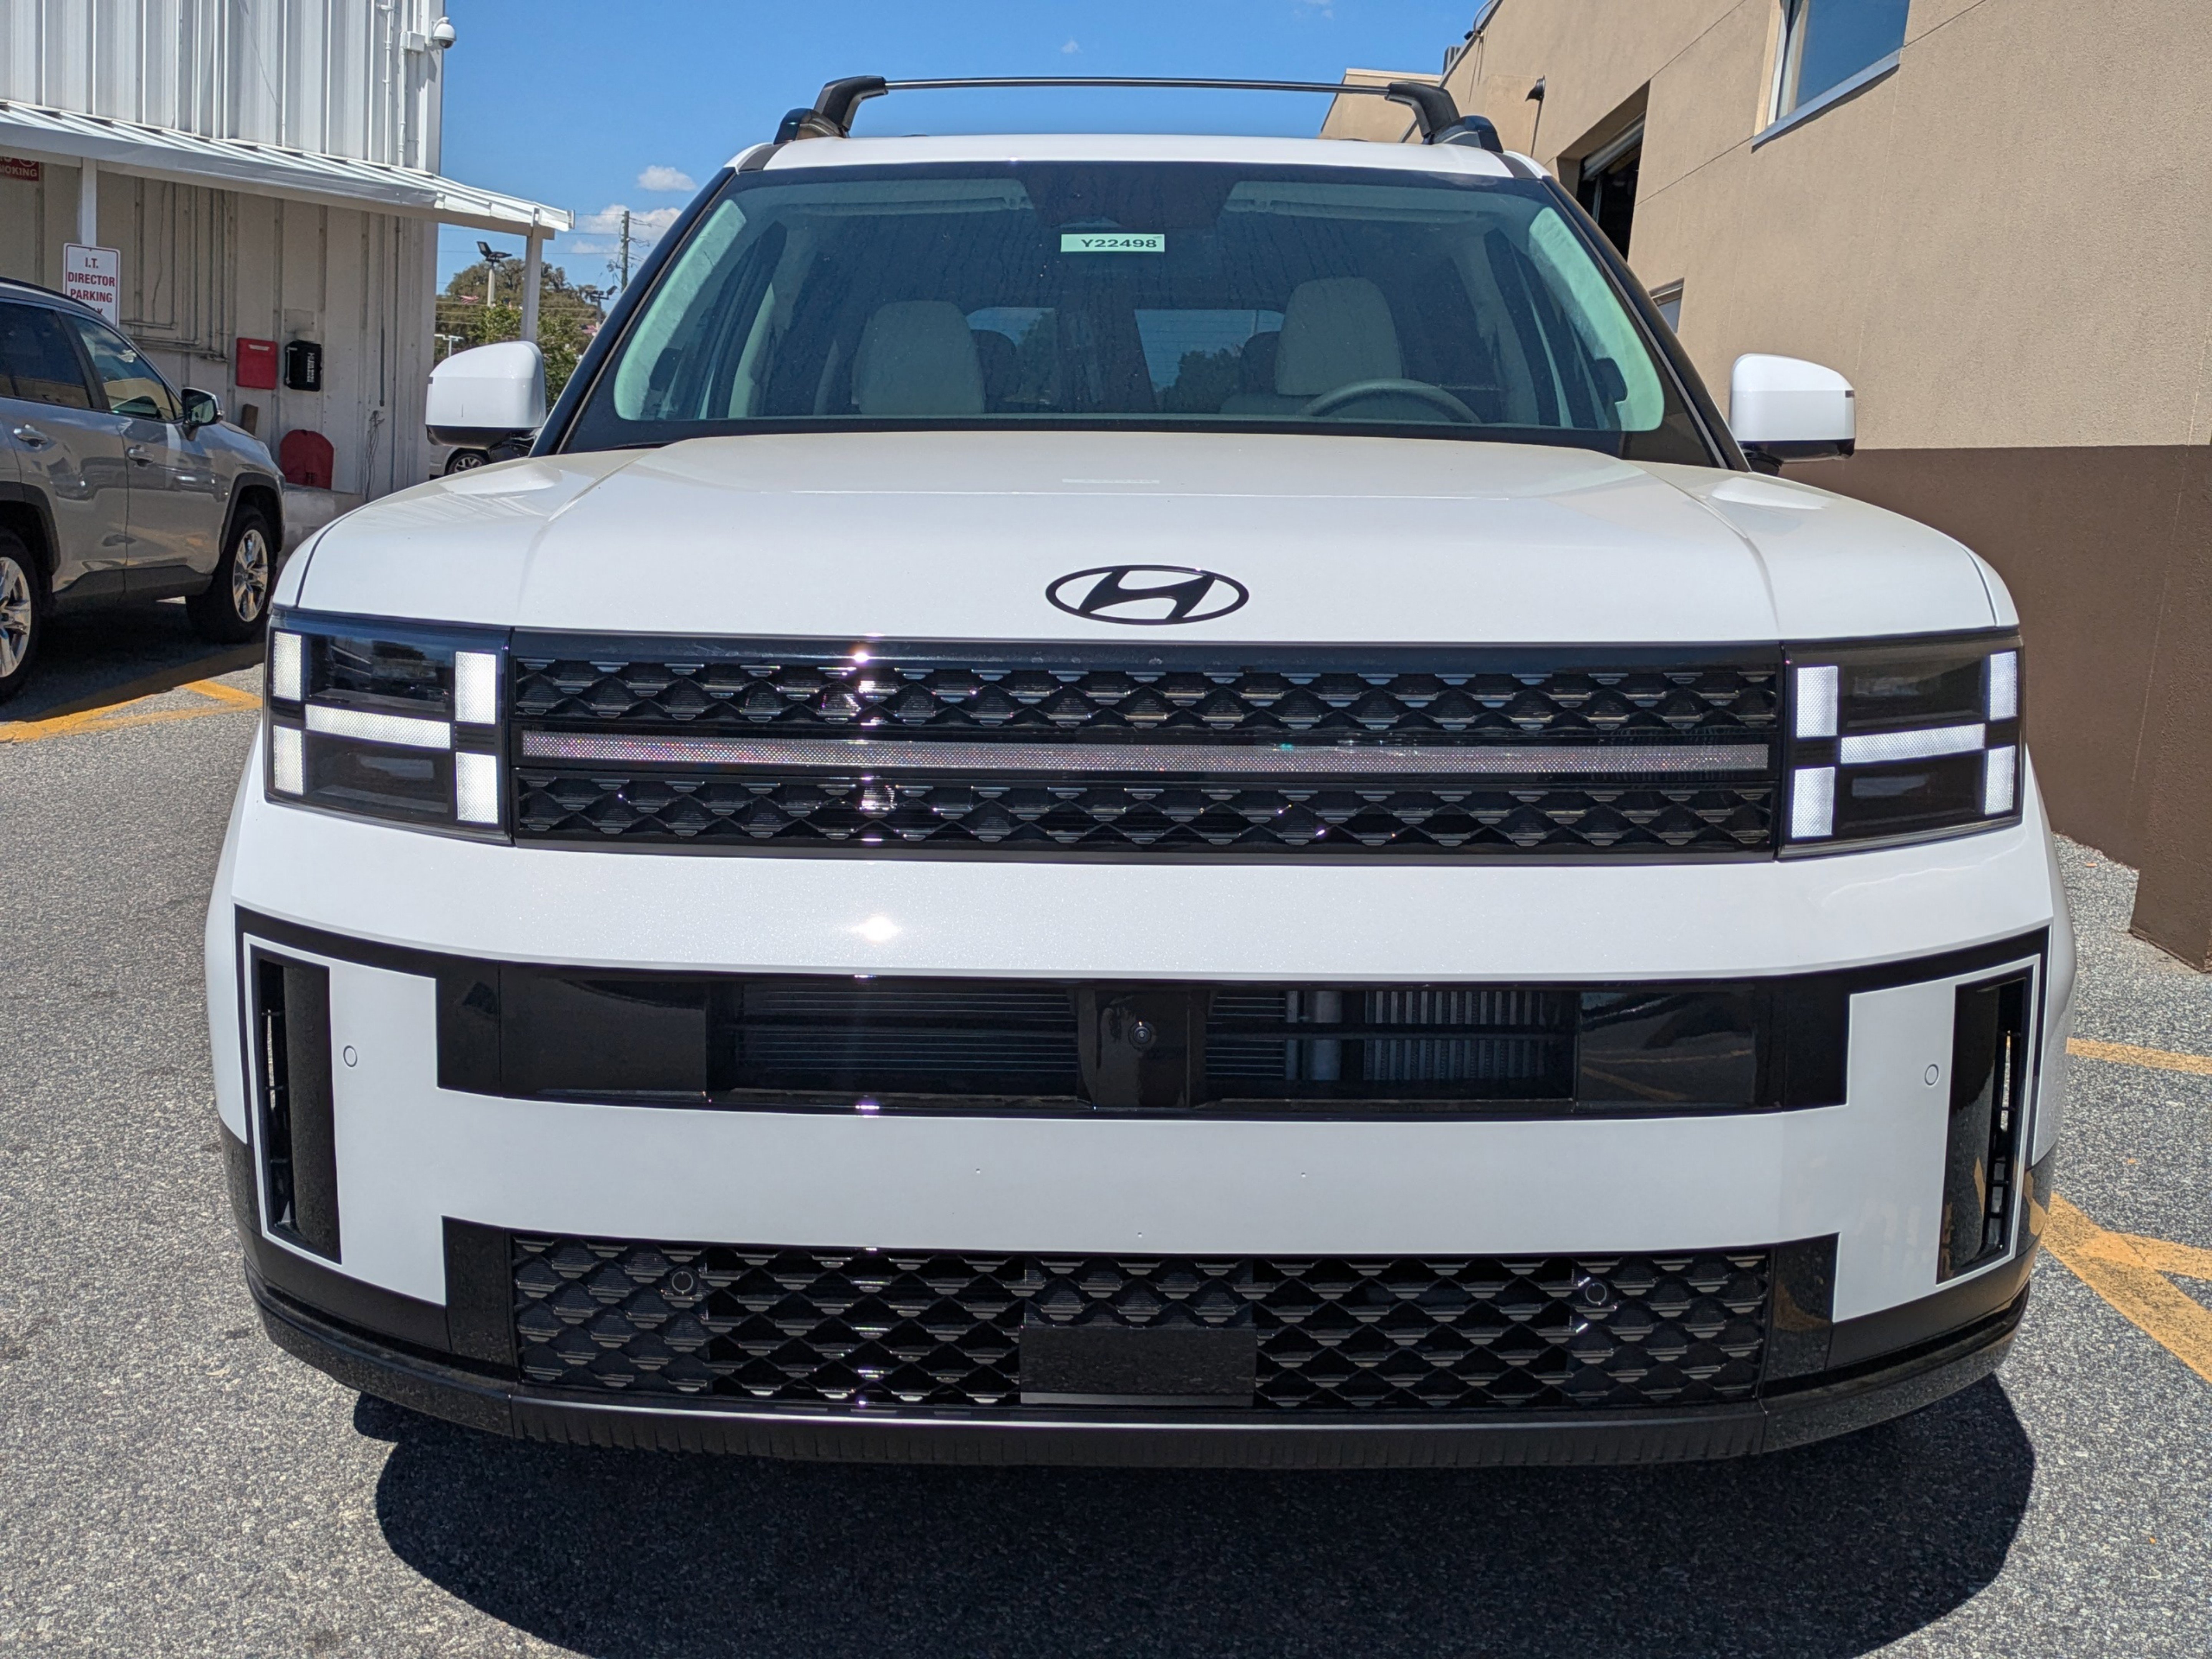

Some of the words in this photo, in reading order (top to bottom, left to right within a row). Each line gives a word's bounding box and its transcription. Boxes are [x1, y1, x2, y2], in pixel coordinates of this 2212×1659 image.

[1081, 239, 1157, 247] Y22498
[85, 257, 99, 268] I.T.
[68, 272, 115, 287] DIRECTOR
[71, 288, 113, 303] PARKING
